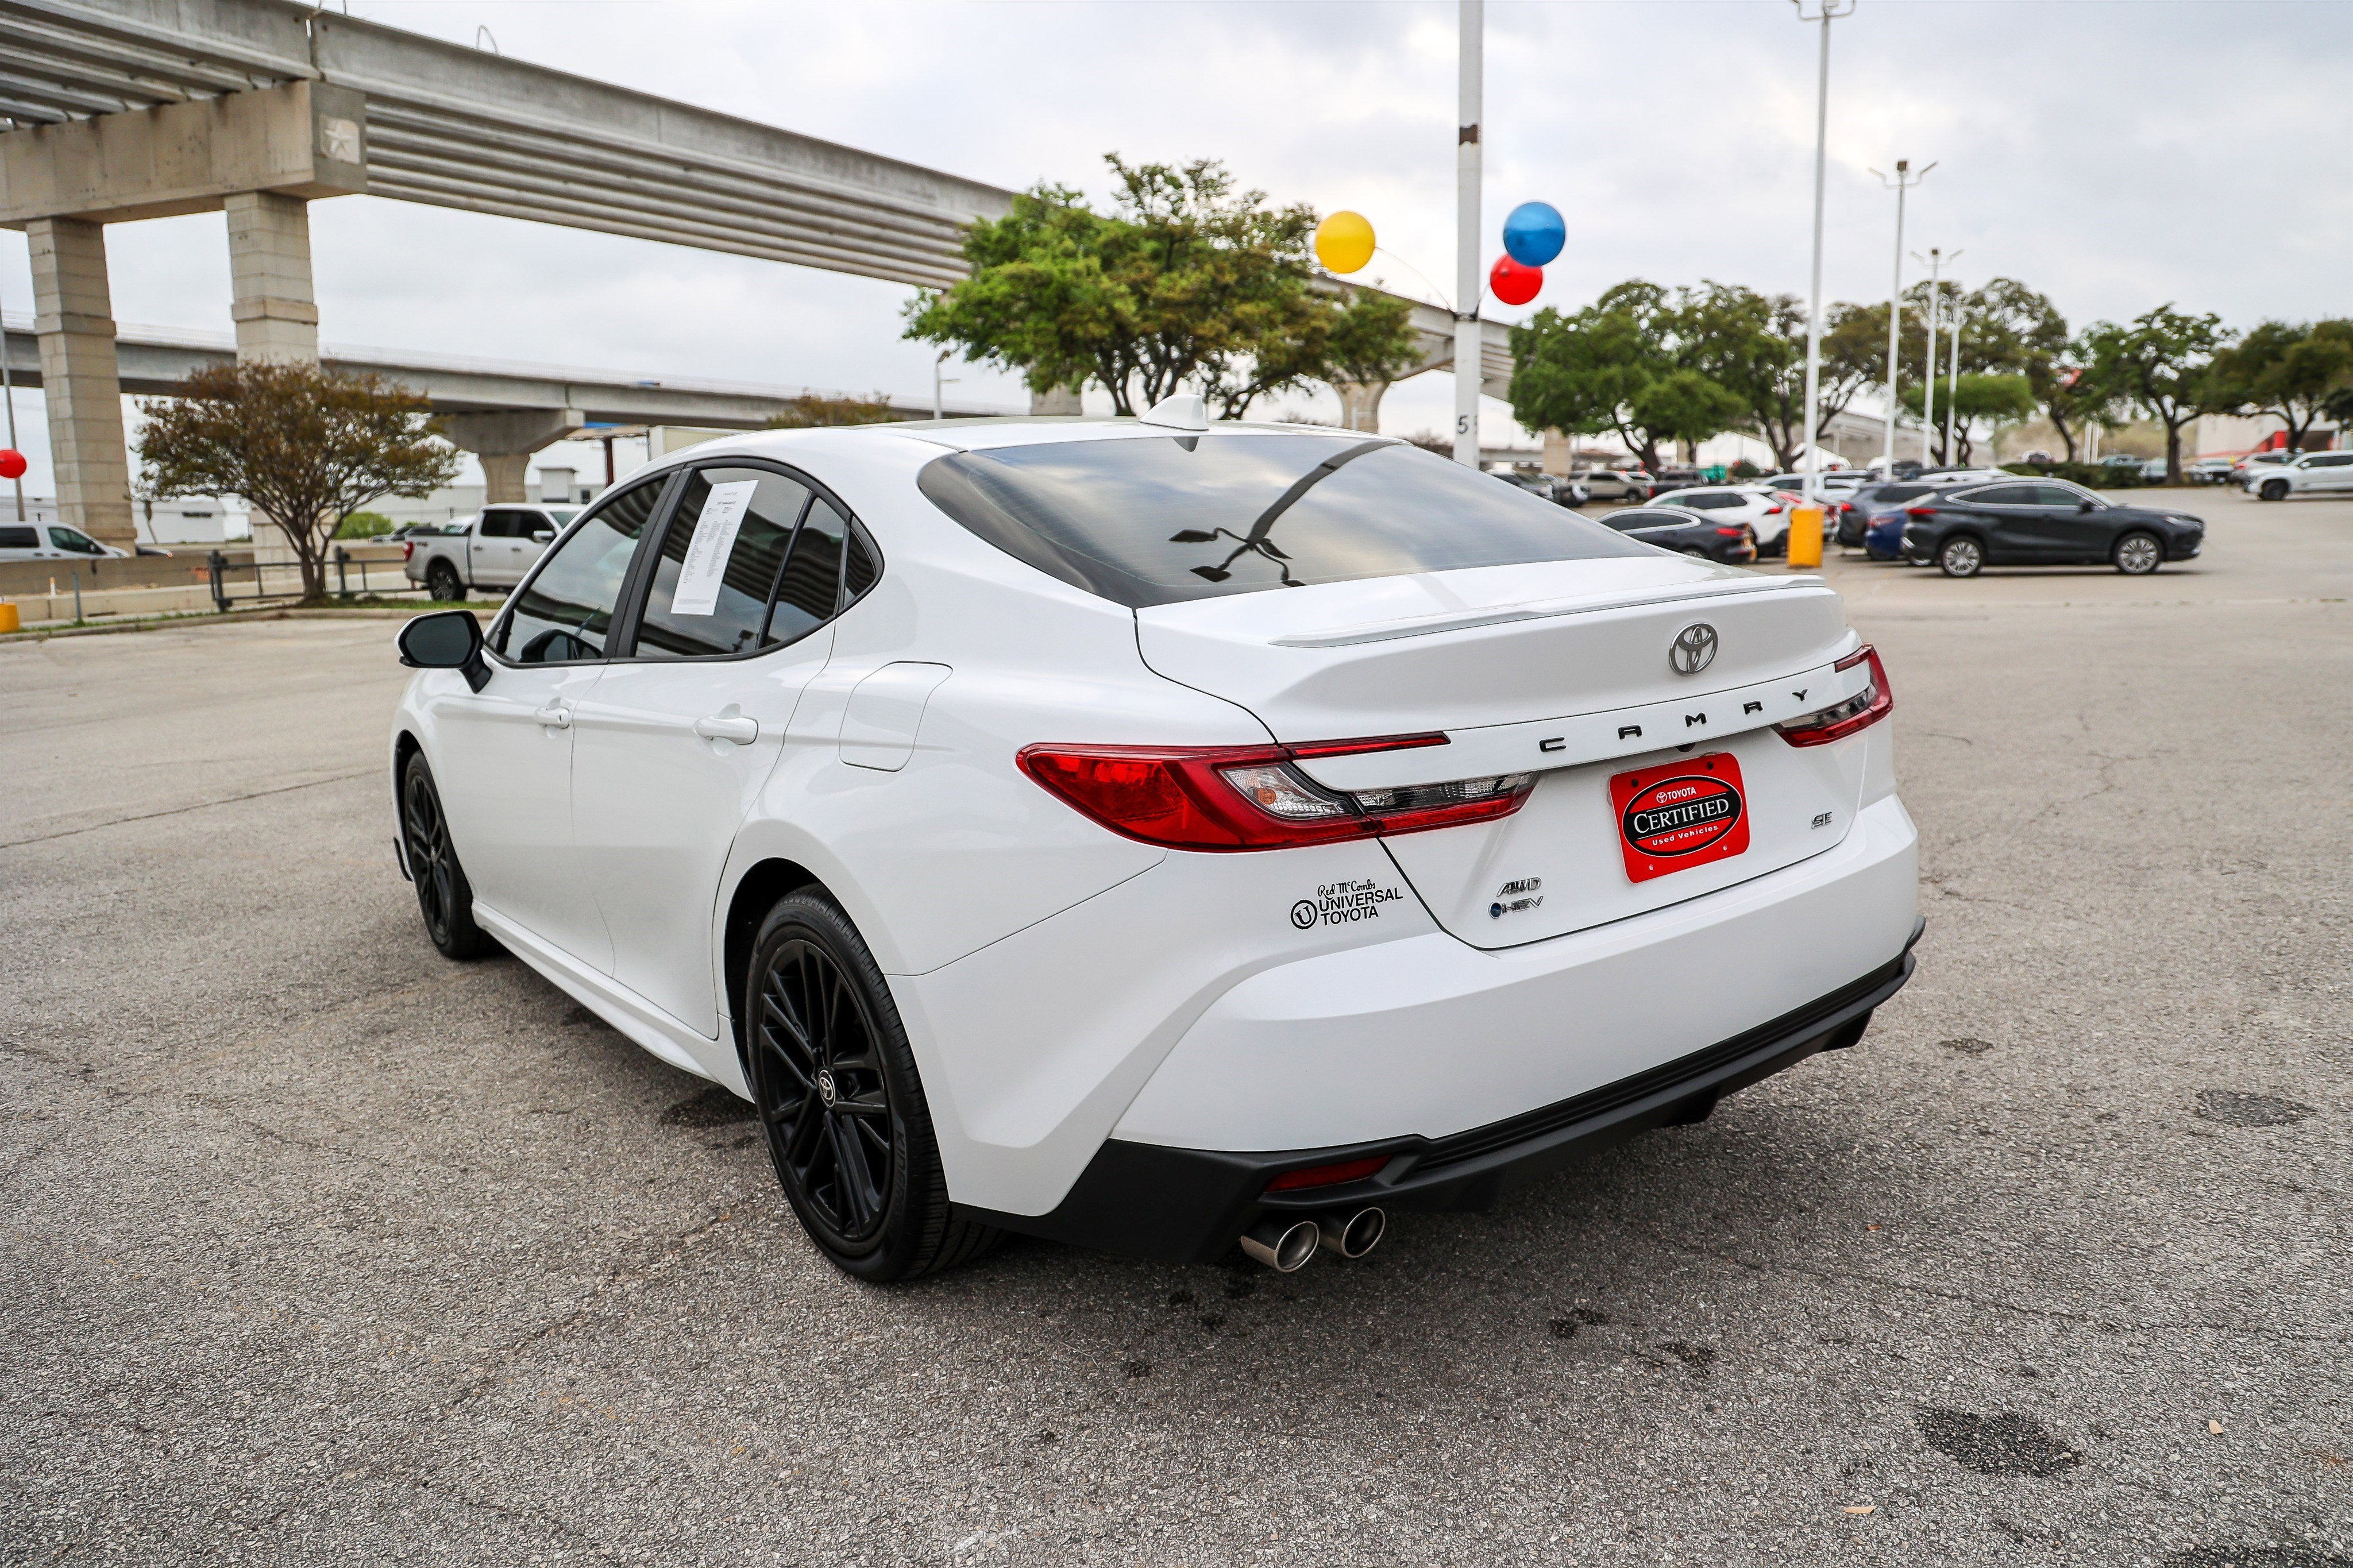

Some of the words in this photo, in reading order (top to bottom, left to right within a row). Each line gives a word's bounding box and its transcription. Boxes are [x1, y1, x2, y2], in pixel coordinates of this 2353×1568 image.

[1539, 688, 1808, 752] CAMRY
[1667, 786, 1697, 801] TOYOTA
[1633, 798, 1729, 834] CERTIFIED
[1811, 812, 1834, 829] SE
[1652, 835, 1675, 846] Used
[1677, 825, 1719, 839] Vehicles
[1317, 884, 1336, 900] Red
[1496, 876, 1542, 897] AWD
[1318, 887, 1403, 912] UNIVERSAL
[1501, 895, 1544, 914] HEV
[1320, 905, 1379, 926] TOYOTA
